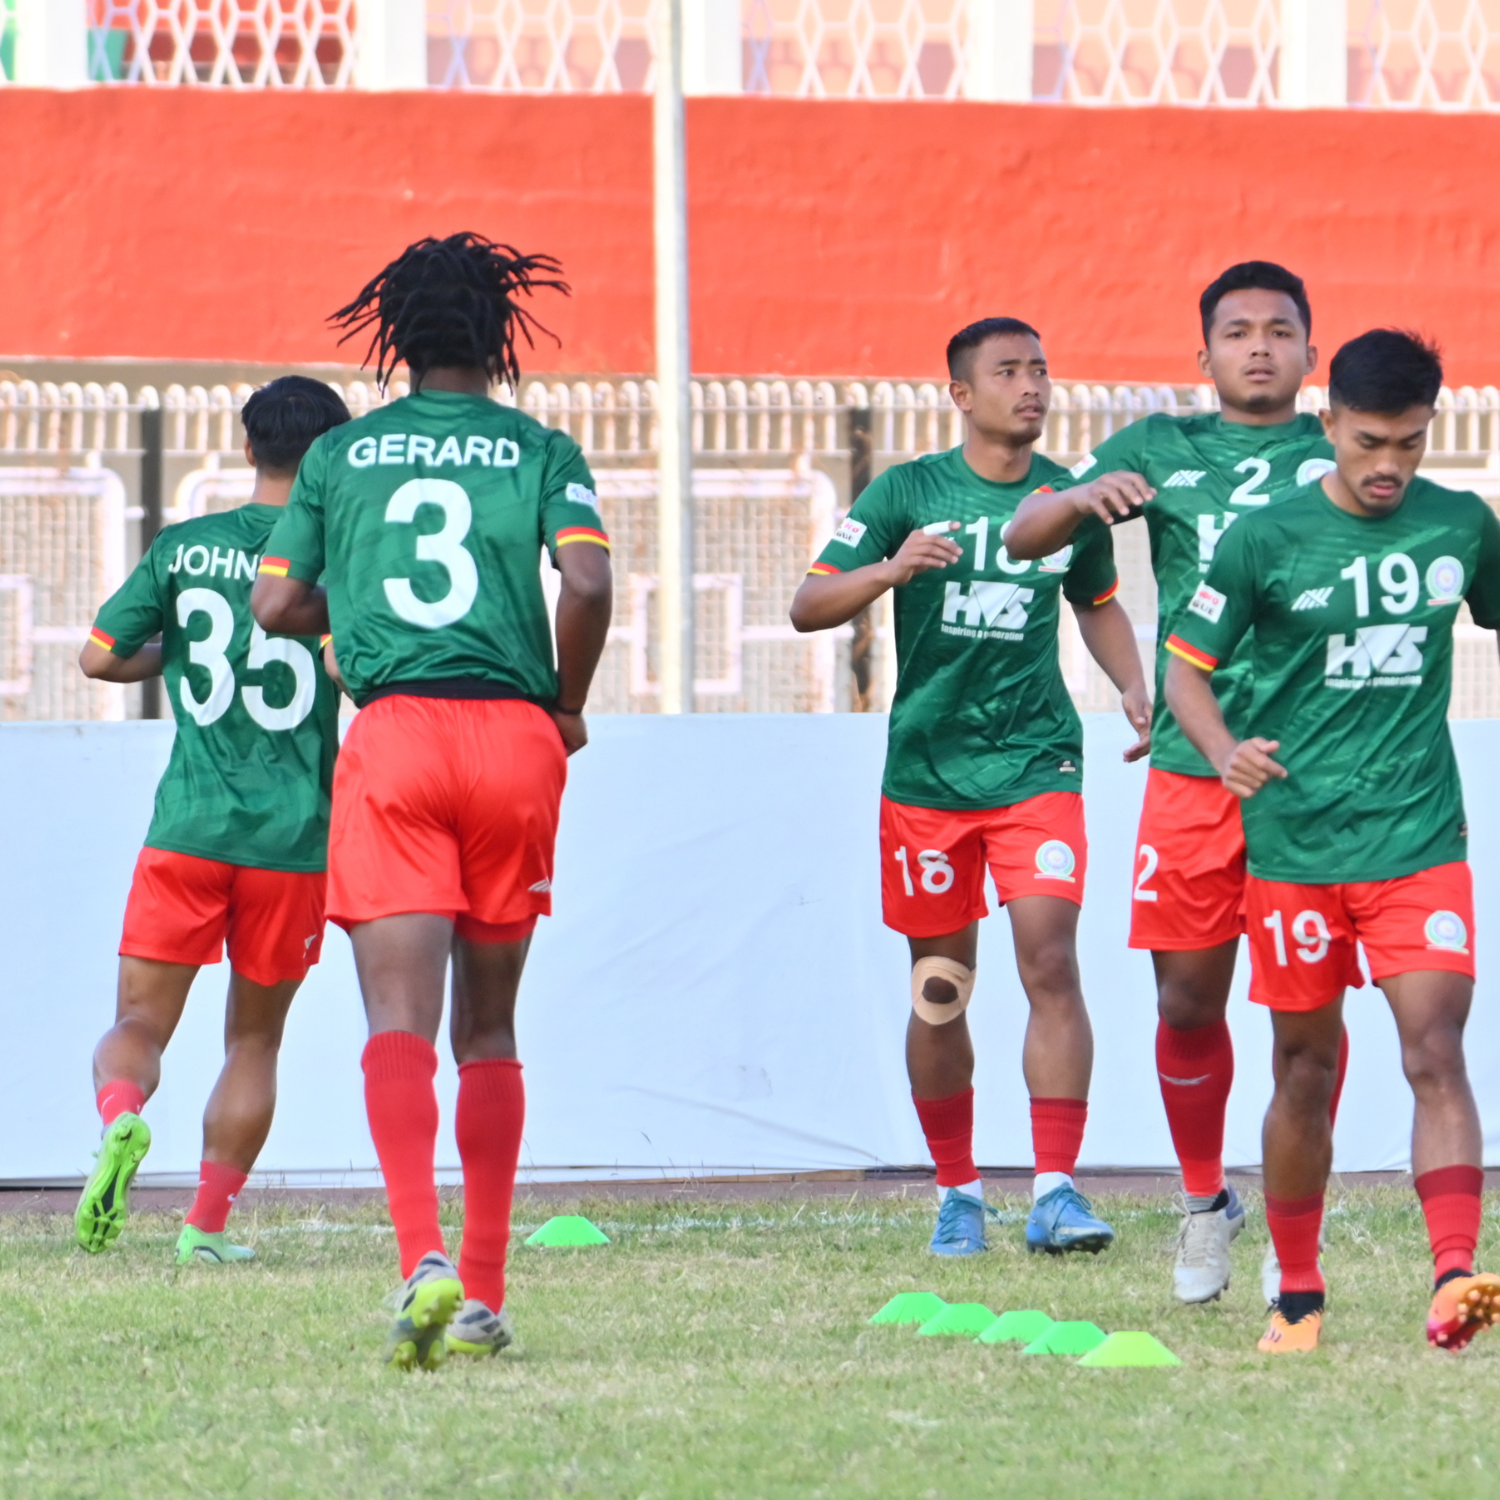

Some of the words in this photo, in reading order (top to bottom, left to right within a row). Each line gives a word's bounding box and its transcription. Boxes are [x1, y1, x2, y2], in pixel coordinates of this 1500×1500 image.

[348, 434, 520, 468] GERARD
[1229, 457, 1271, 506] 2
[383, 478, 479, 629] 3
[1340, 552, 1420, 618] 19
[175, 587, 317, 731] 35
[894, 845, 955, 897] 18
[1133, 844, 1159, 901] 2
[1263, 910, 1332, 967] 19
